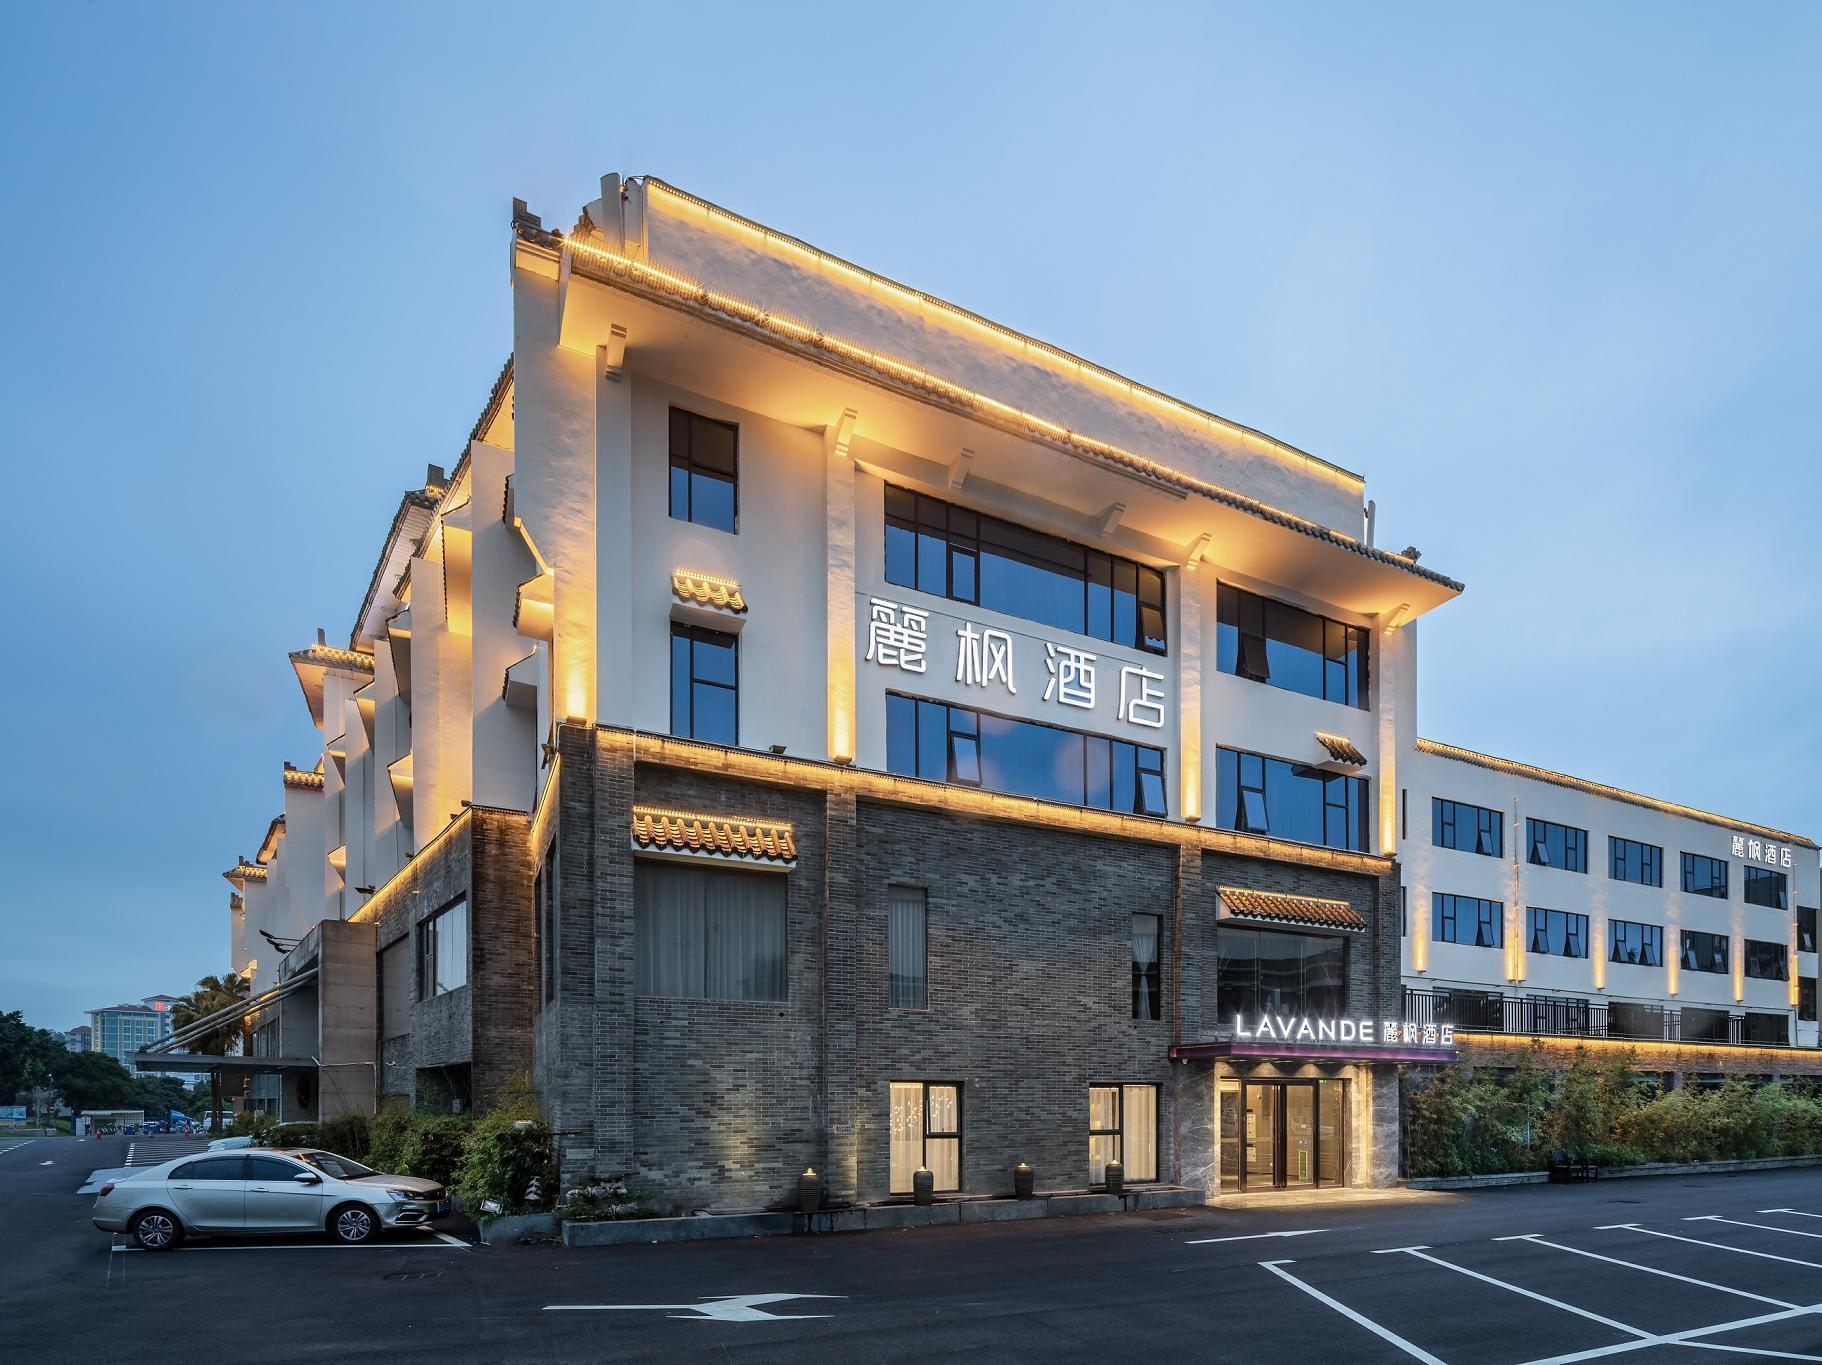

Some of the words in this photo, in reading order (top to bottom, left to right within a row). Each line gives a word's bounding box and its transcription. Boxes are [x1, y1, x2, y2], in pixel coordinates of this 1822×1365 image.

[865, 598, 1165, 728] 麗枫酒店
[1235, 1014, 1374, 1041] LAVANDE
